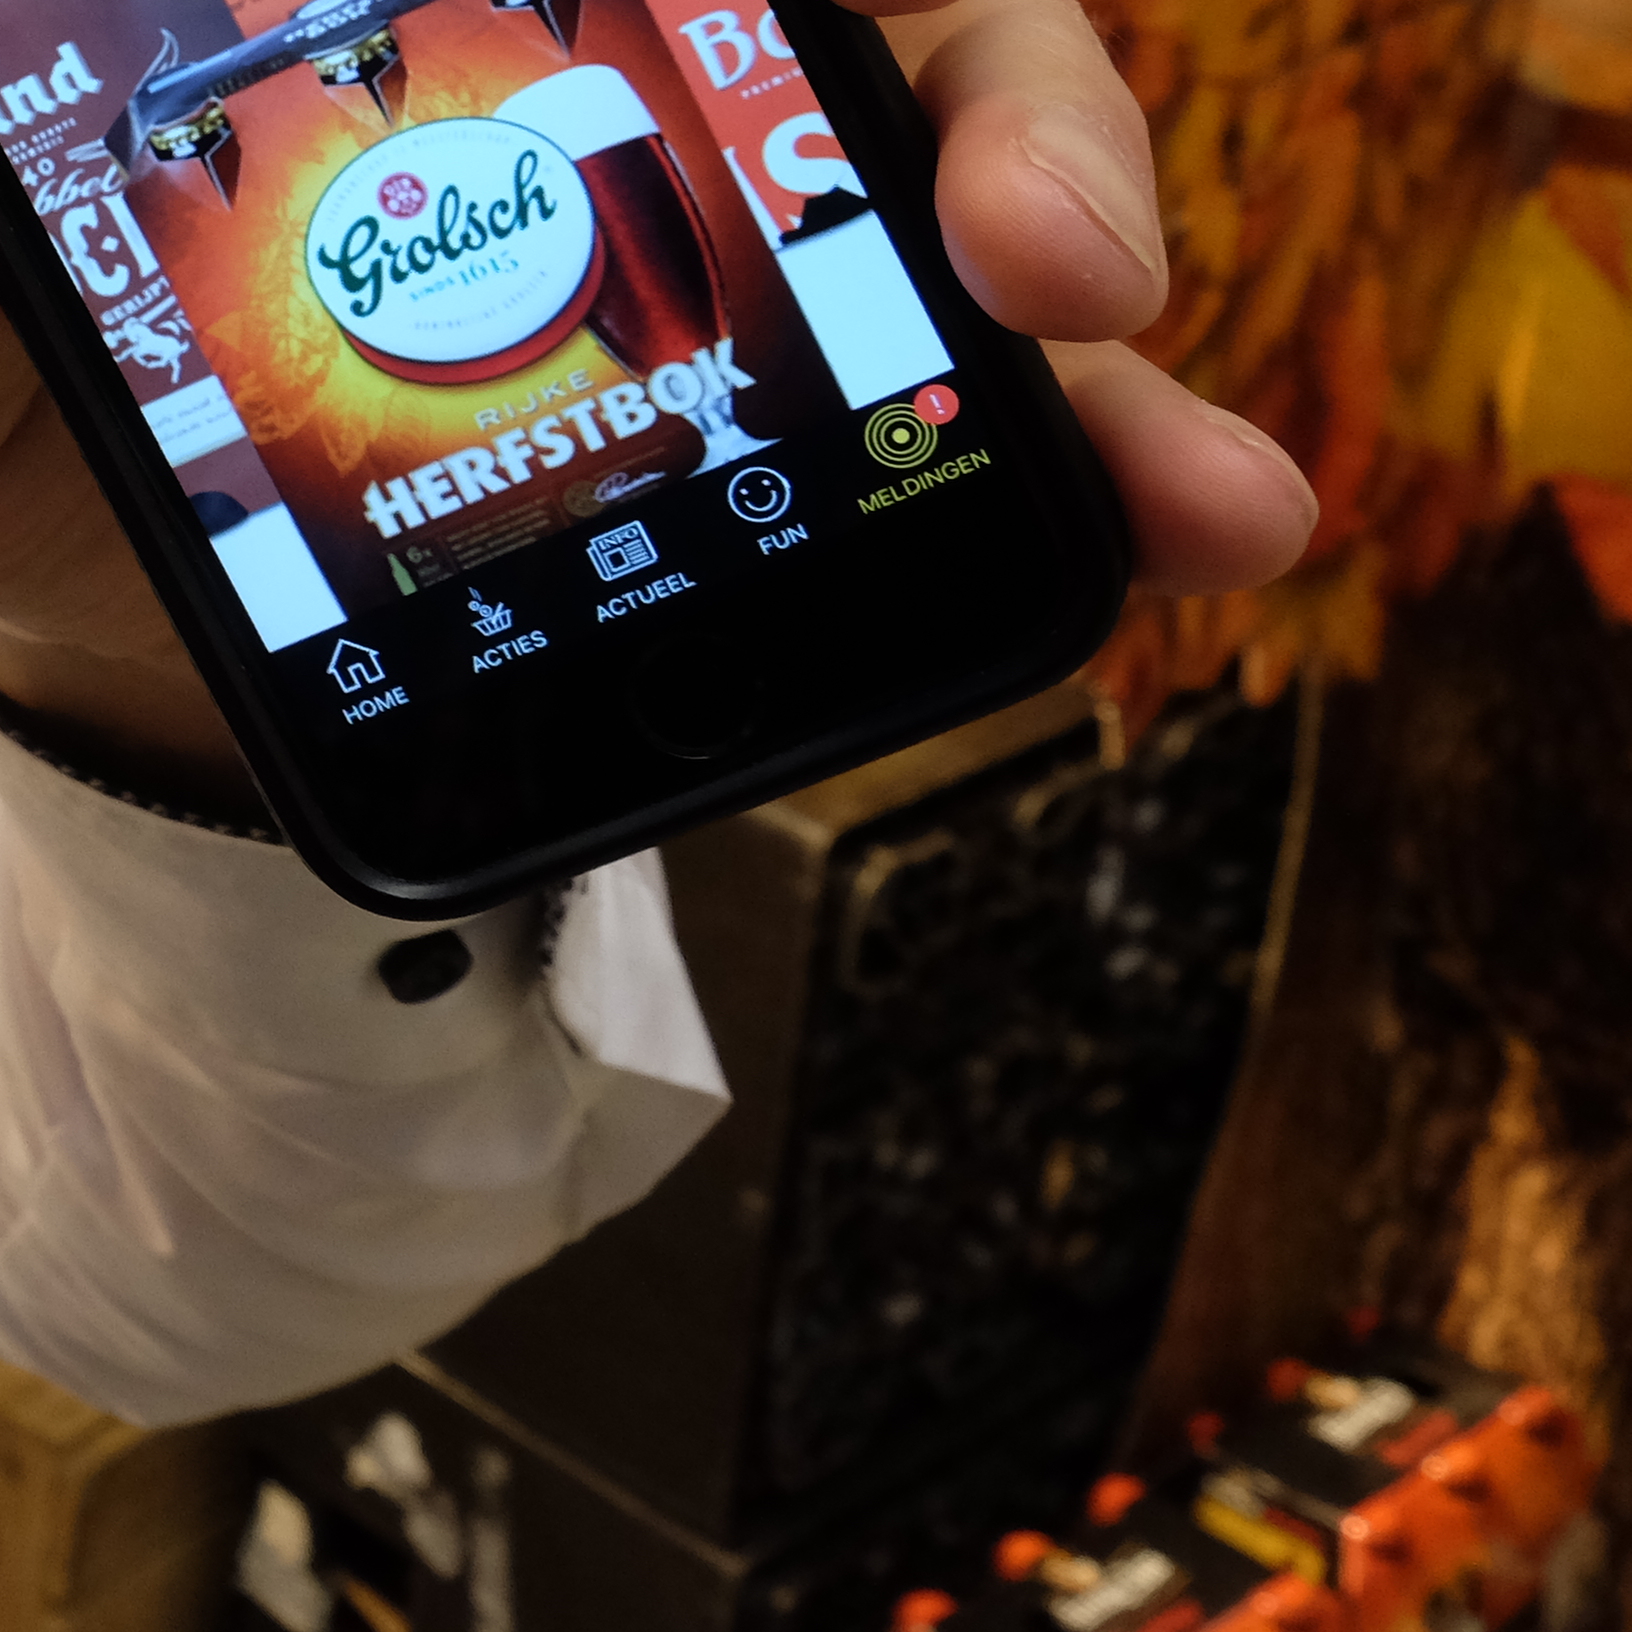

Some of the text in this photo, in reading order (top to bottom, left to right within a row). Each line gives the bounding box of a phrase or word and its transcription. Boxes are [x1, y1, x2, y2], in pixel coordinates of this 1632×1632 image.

[317, 148, 558, 318] Grolsch
[362, 336, 757, 540] HERFSTBOK
[474, 368, 595, 431] RIJKE
[342, 448, 992, 725] HOME ACTIES ACTUEEL FUN MELDINGEN
